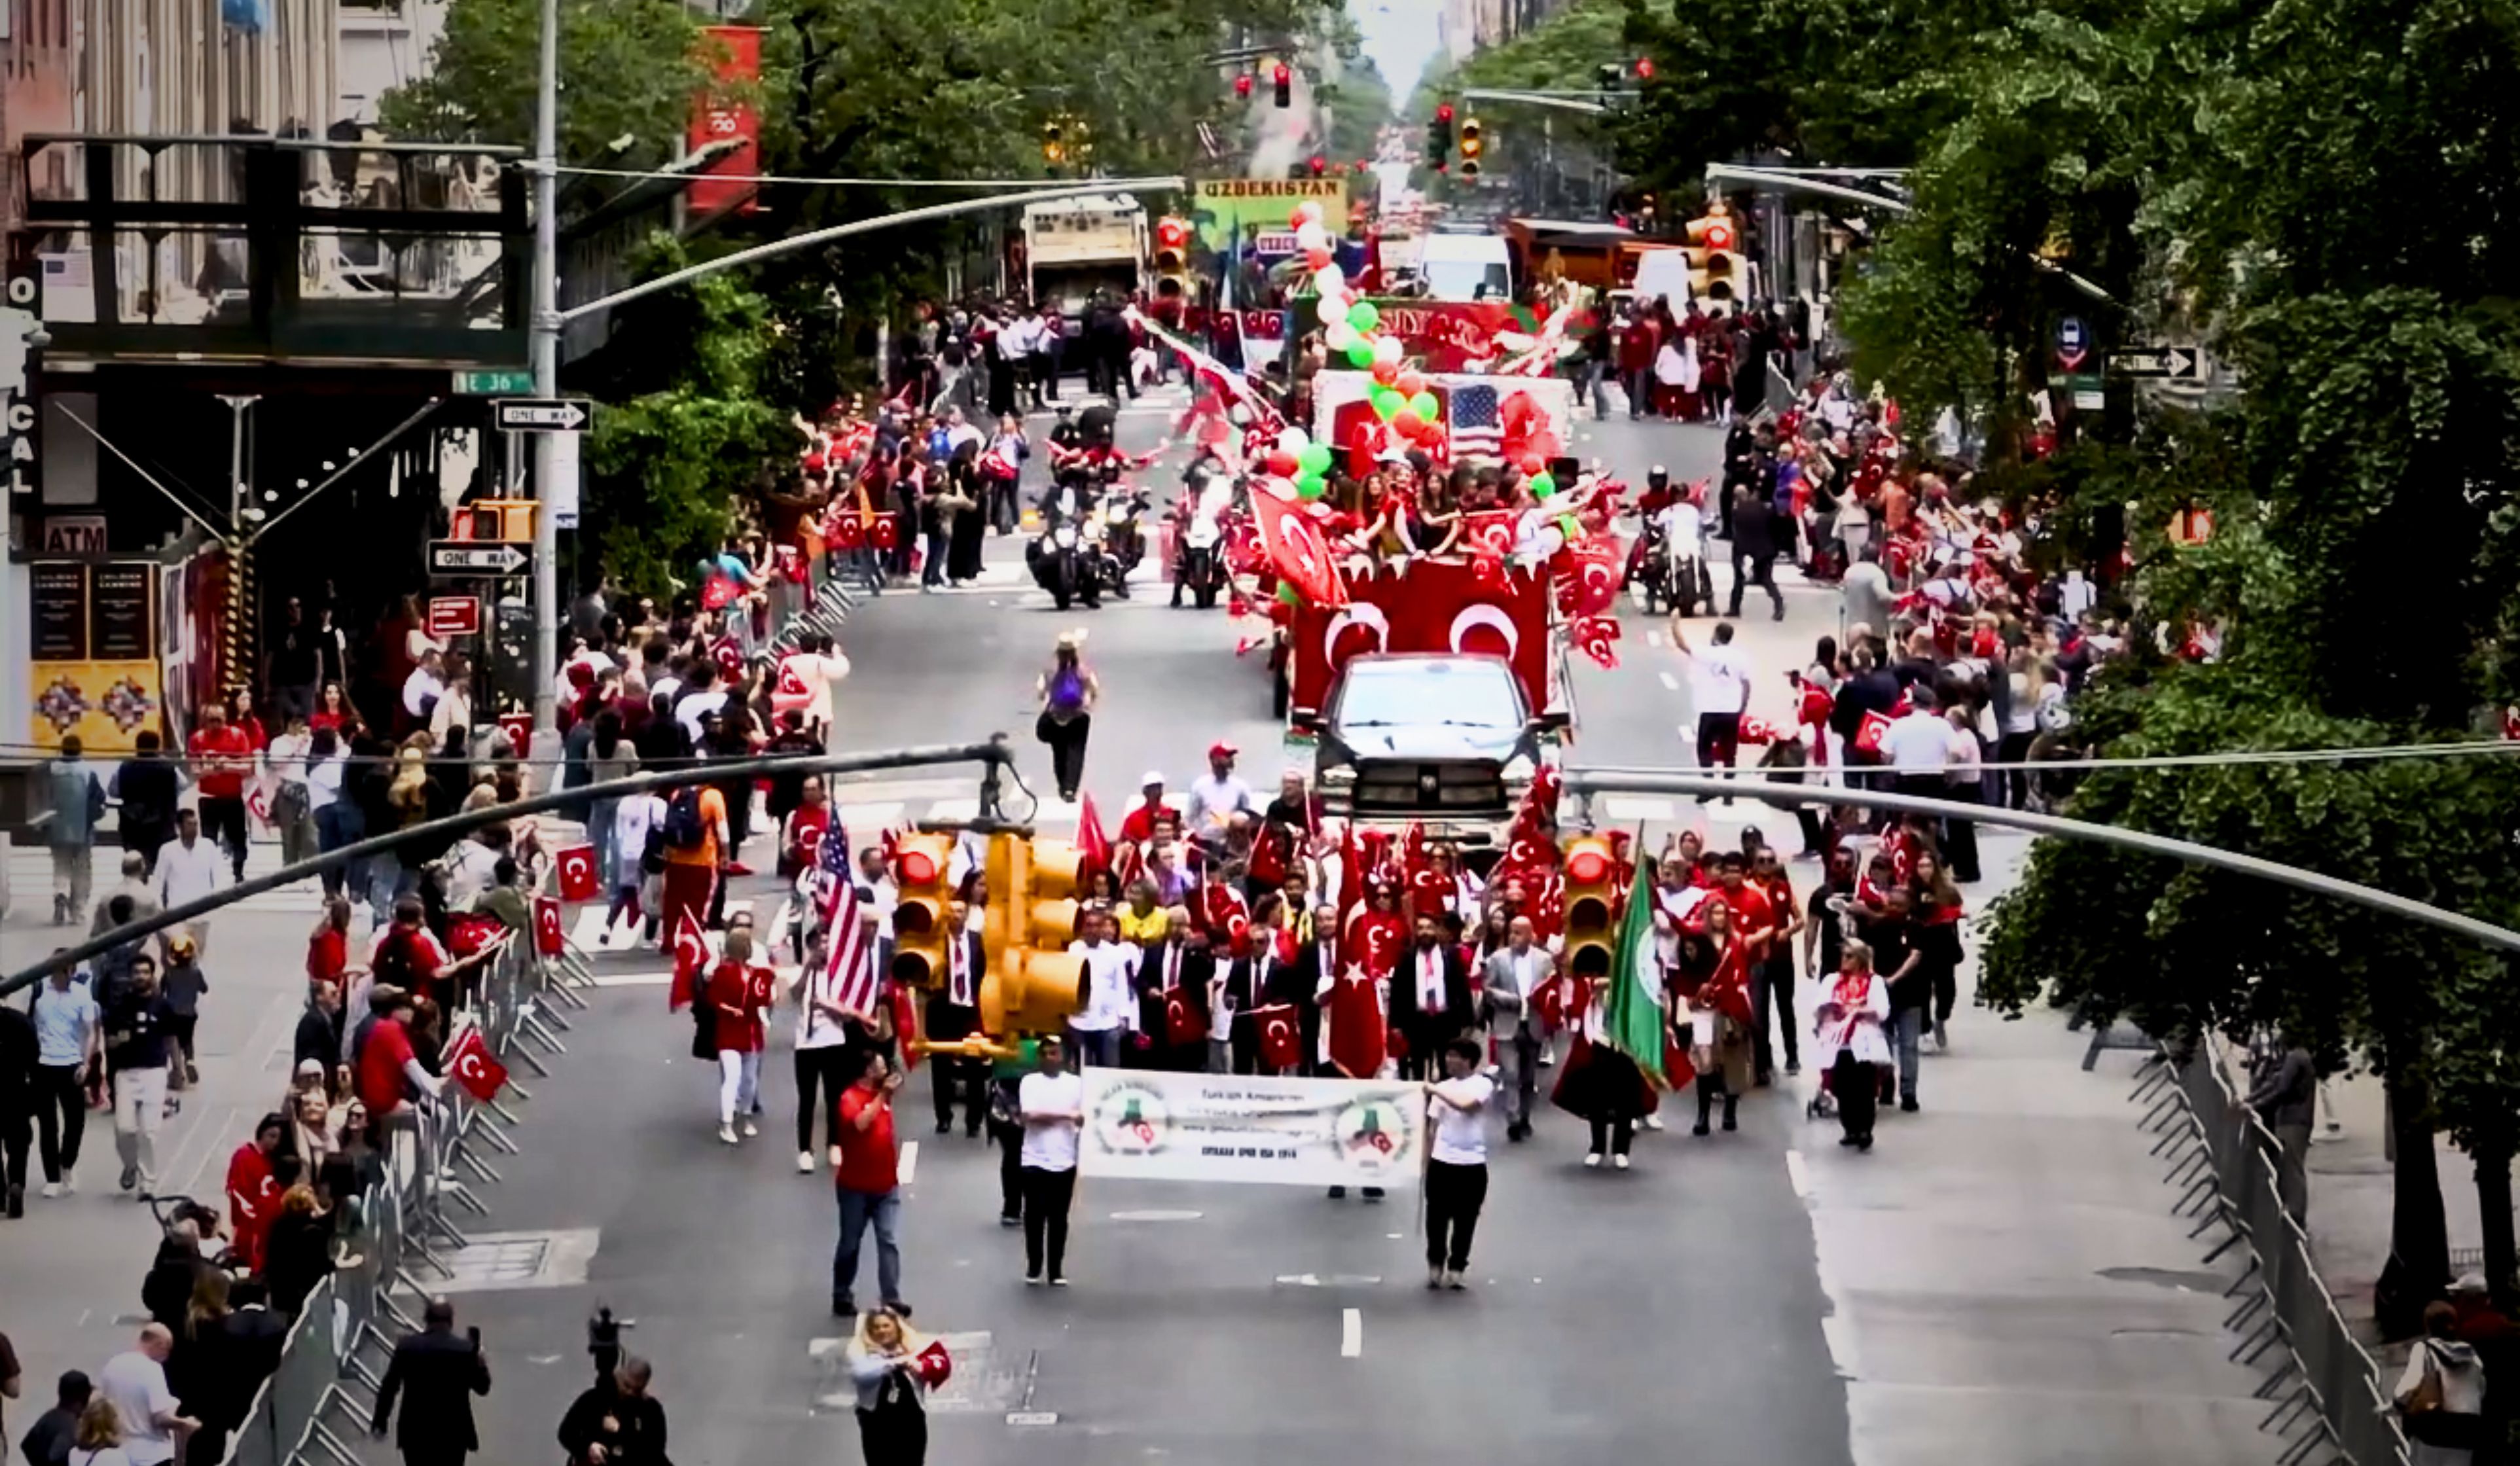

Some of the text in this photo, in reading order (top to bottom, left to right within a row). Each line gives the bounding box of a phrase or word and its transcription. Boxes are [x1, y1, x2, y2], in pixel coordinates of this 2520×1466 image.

[469, 373, 478, 391] E
[511, 410, 577, 421] ONE WAY
[48, 526, 105, 552] ATM
[443, 552, 516, 565] ONE WAY
